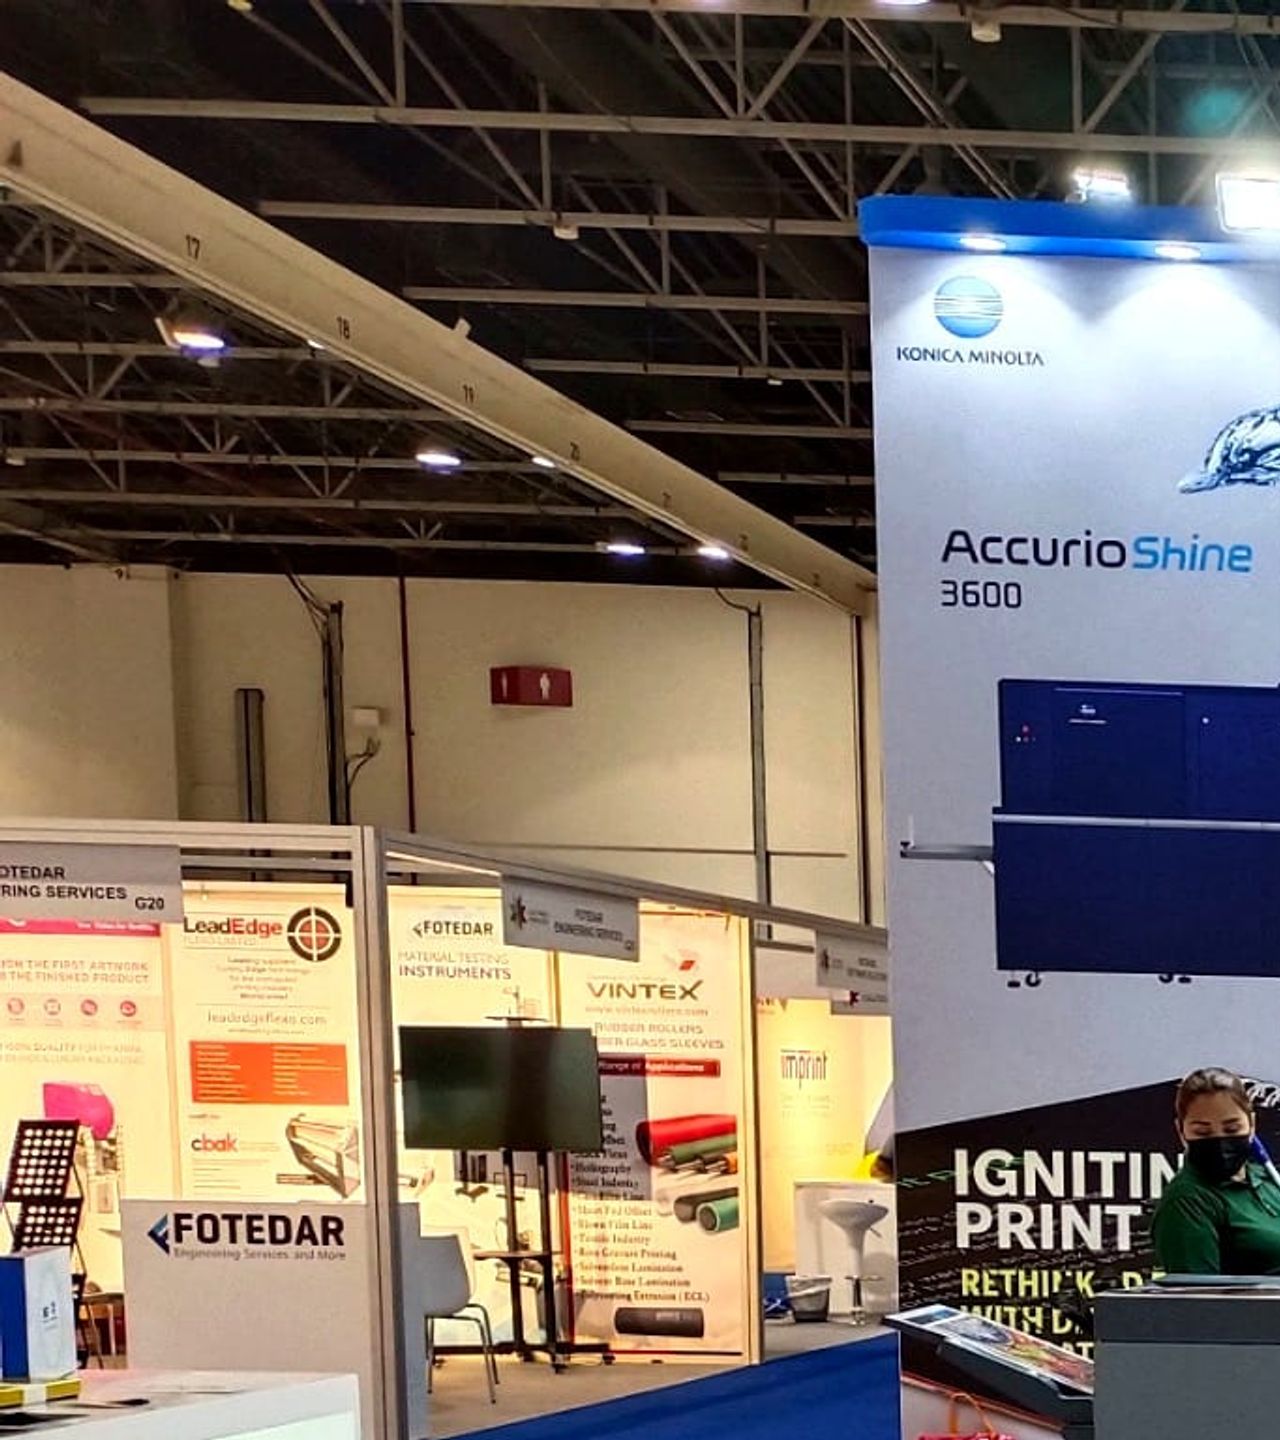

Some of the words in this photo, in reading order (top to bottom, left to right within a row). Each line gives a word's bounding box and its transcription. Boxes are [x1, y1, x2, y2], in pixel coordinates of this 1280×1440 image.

[897, 346, 964, 364] KONICA
[968, 348, 1044, 367] MINOLTA
[941, 529, 1253, 573] AccurioShine
[941, 580, 1022, 608] 3600
[46, 886, 128, 900] SERVICES
[135, 897, 164, 910] G20
[184, 917, 283, 939] LeadEdge
[424, 921, 493, 935] FOTEDAR
[399, 965, 512, 980] INSTRUMENTS
[587, 980, 703, 1000] VINTEX
[781, 1052, 828, 1090] imprint
[954, 1149, 1185, 1199] IGNITIN
[174, 1213, 345, 1247] FOTEDAR
[955, 1202, 1142, 1251] PRINT
[174, 1249, 242, 1261] Engineering
[293, 1250, 315, 1260] and
[317, 1250, 347, 1261] More
